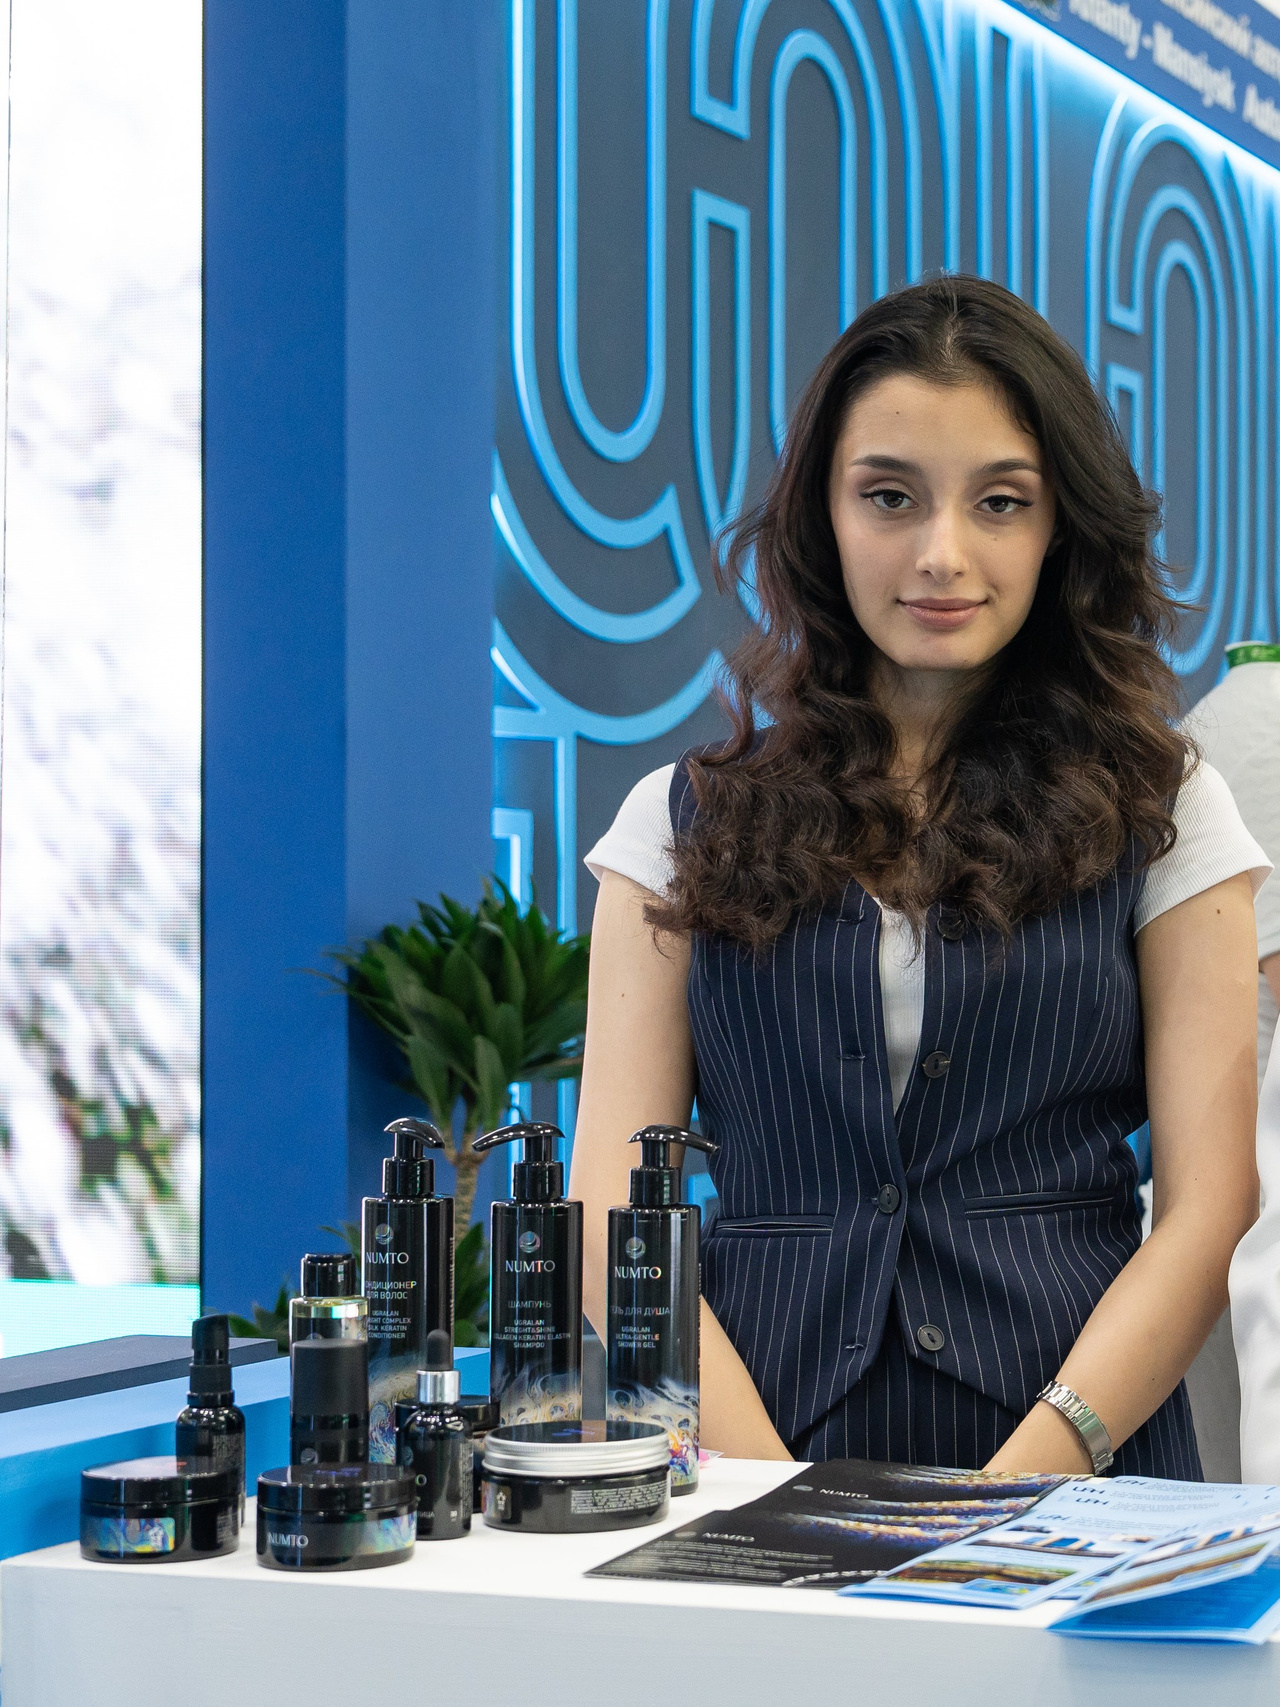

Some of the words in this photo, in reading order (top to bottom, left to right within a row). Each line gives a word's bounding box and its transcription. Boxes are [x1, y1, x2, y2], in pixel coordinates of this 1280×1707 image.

[366, 1252, 409, 1264] NUMTO
[505, 1260, 556, 1273] NUMTO
[614, 1266, 662, 1279] NUMTO
[380, 1291, 409, 1300] ВОЛОС
[508, 1300, 552, 1309] ШАМПУНЬ
[624, 1306, 643, 1316] ДЛЯ
[644, 1306, 671, 1316] ДУША
[819, 1488, 869, 1499] NUMTO
[267, 1532, 309, 1548] NUMTO
